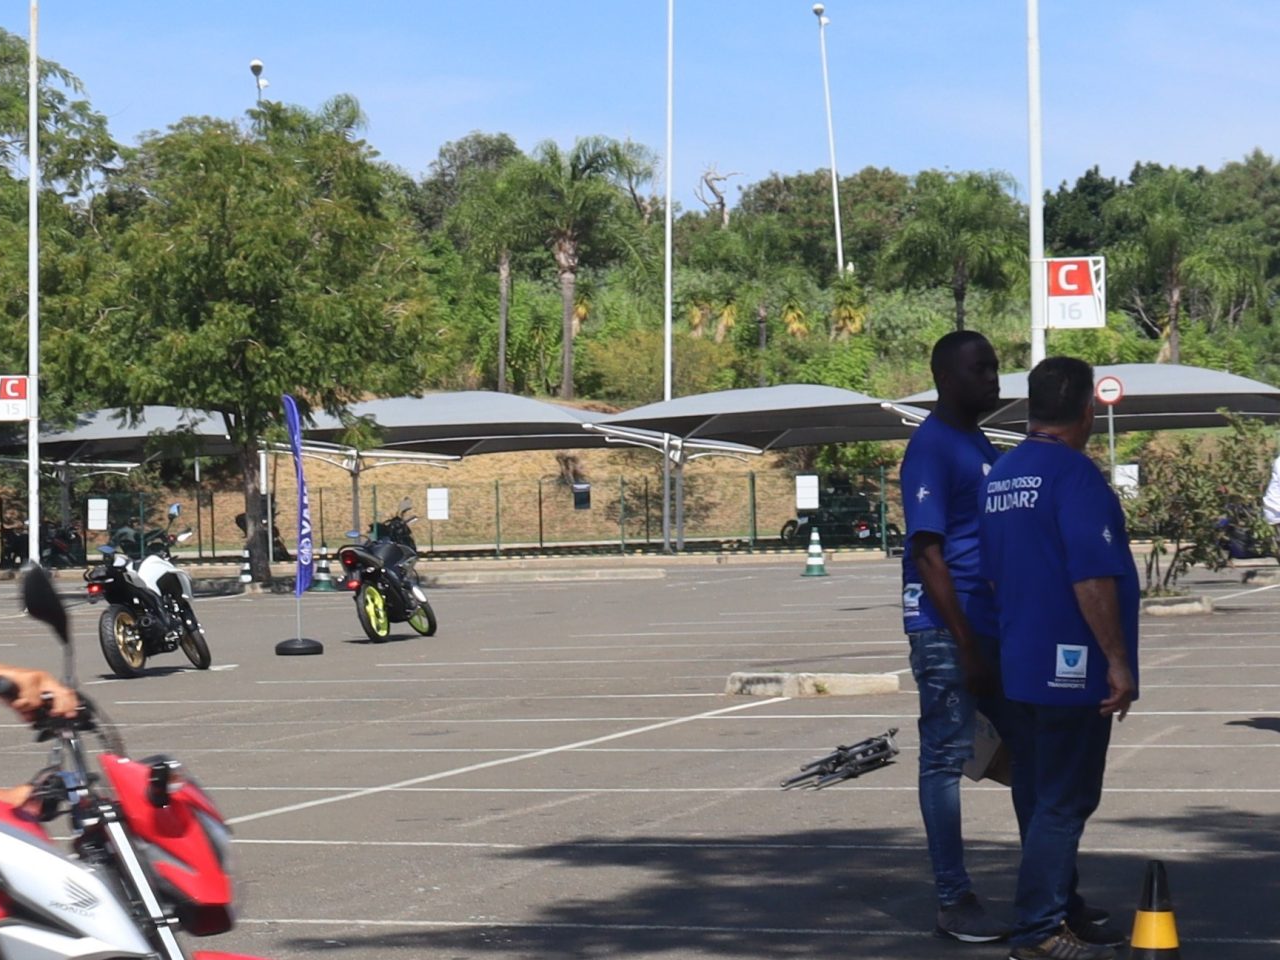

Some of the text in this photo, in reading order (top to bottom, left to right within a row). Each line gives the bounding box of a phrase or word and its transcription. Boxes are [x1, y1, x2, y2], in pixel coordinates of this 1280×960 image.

[1058, 264, 1079, 291] C
[1060, 302, 1082, 320] 16
[6, 380, 19, 397] C
[6, 403, 20, 415] 15
[987, 476, 1042, 493] COMO POSSO
[985, 490, 1039, 513] AJUDAR?
